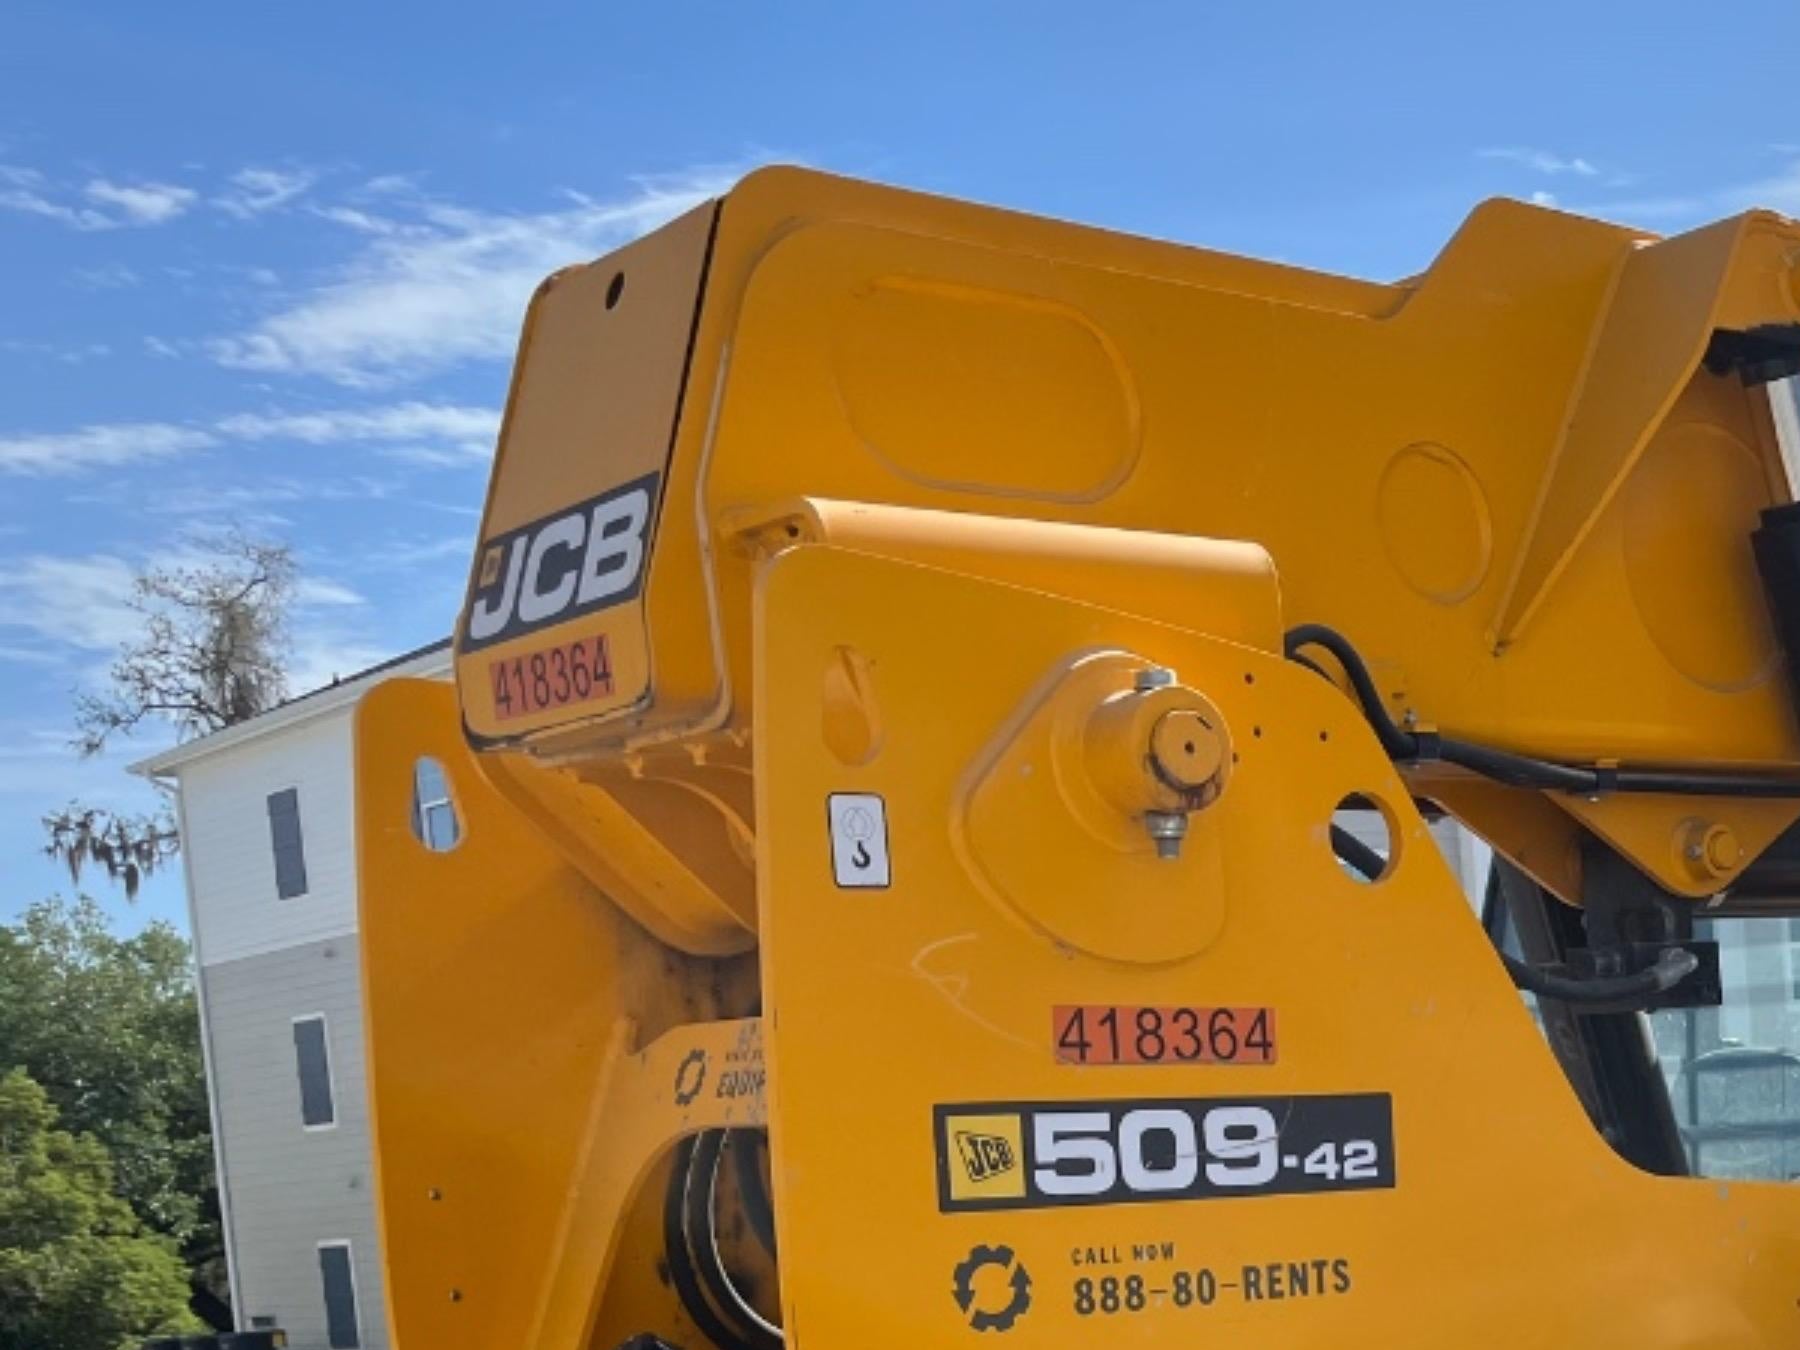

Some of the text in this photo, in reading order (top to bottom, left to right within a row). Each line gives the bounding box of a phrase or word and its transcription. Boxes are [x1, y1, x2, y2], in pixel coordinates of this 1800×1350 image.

[470, 487, 649, 639] JCB
[495, 633, 612, 715] 418364
[1057, 1007, 1274, 1062] 418364
[1071, 1242, 1175, 1266] CALL NOW
[1073, 1259, 1352, 1316] 888-80-RENTS
